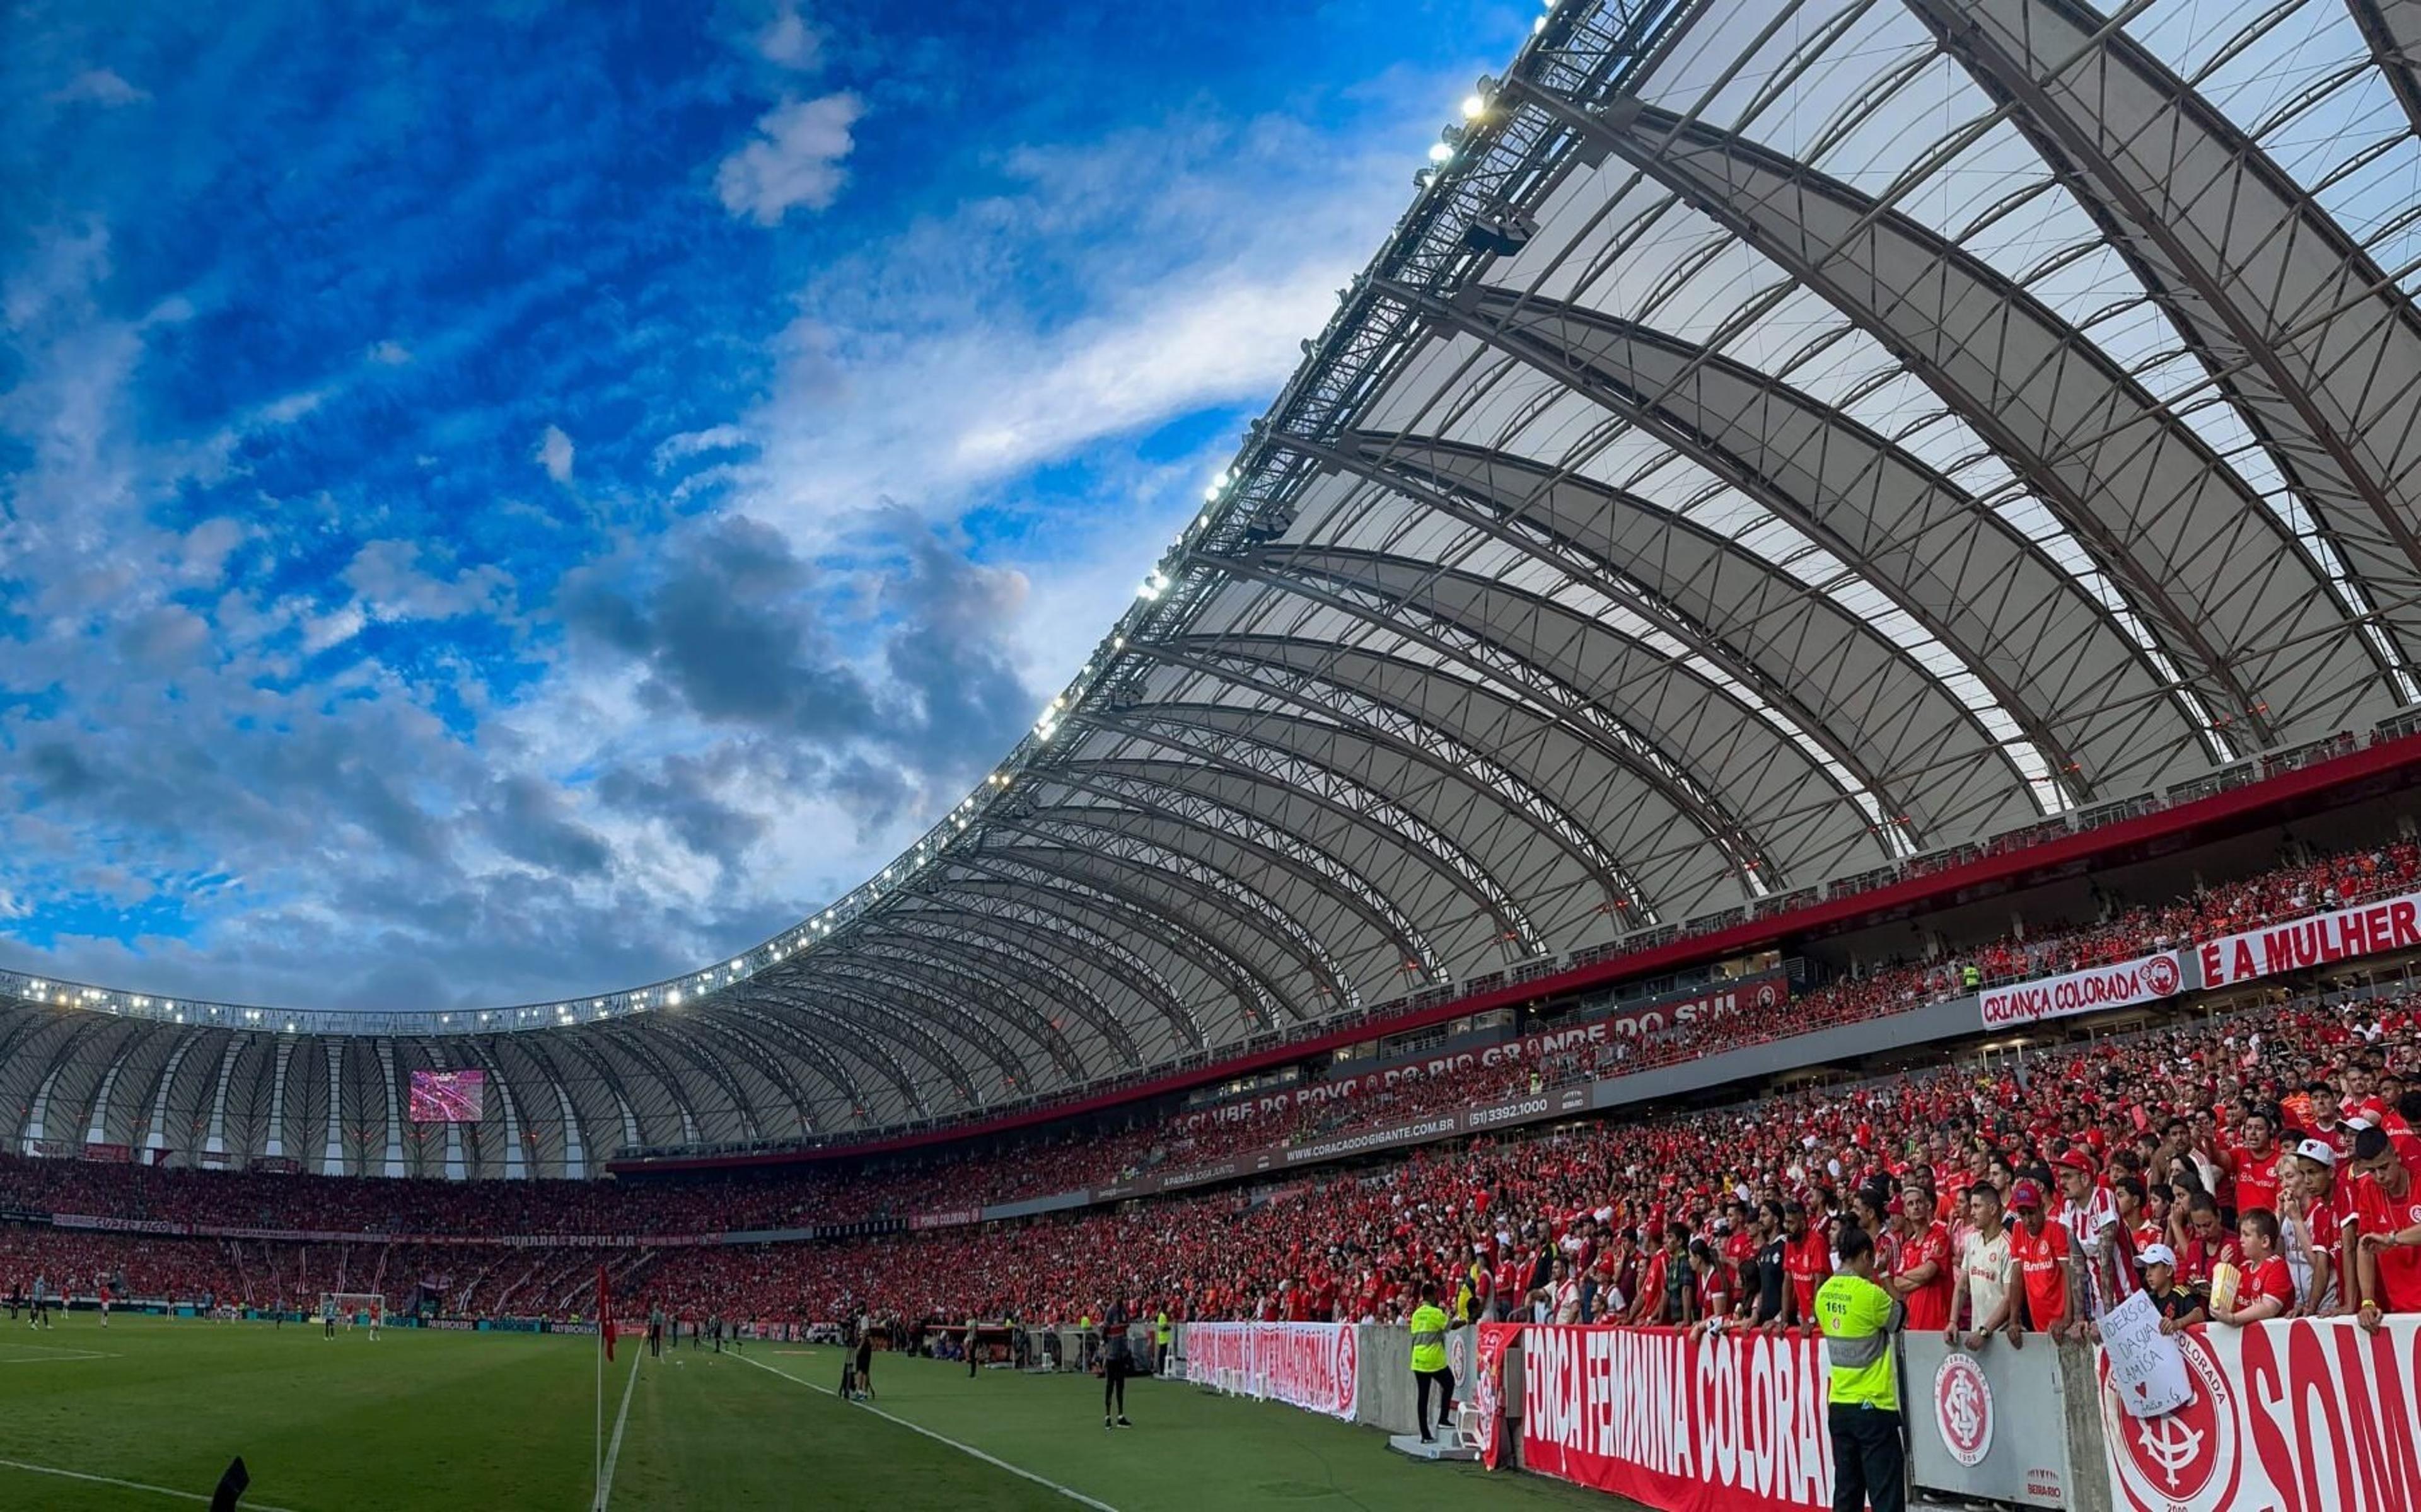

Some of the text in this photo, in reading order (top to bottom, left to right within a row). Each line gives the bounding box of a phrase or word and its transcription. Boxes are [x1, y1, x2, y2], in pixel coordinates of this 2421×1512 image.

[2202, 942, 2223, 987] É
[2233, 939, 2257, 980] A
[1984, 986, 2052, 1020] CRIANÇA
[2054, 970, 2141, 1010] COLORADA
[570, 1235, 635, 1246] POPULAR
[1826, 1301, 1847, 1315] 1615
[1524, 1327, 1582, 1473] FORÇA
[1586, 1329, 1695, 1478] FEMININA
[2241, 1319, 2421, 1512] SOM
